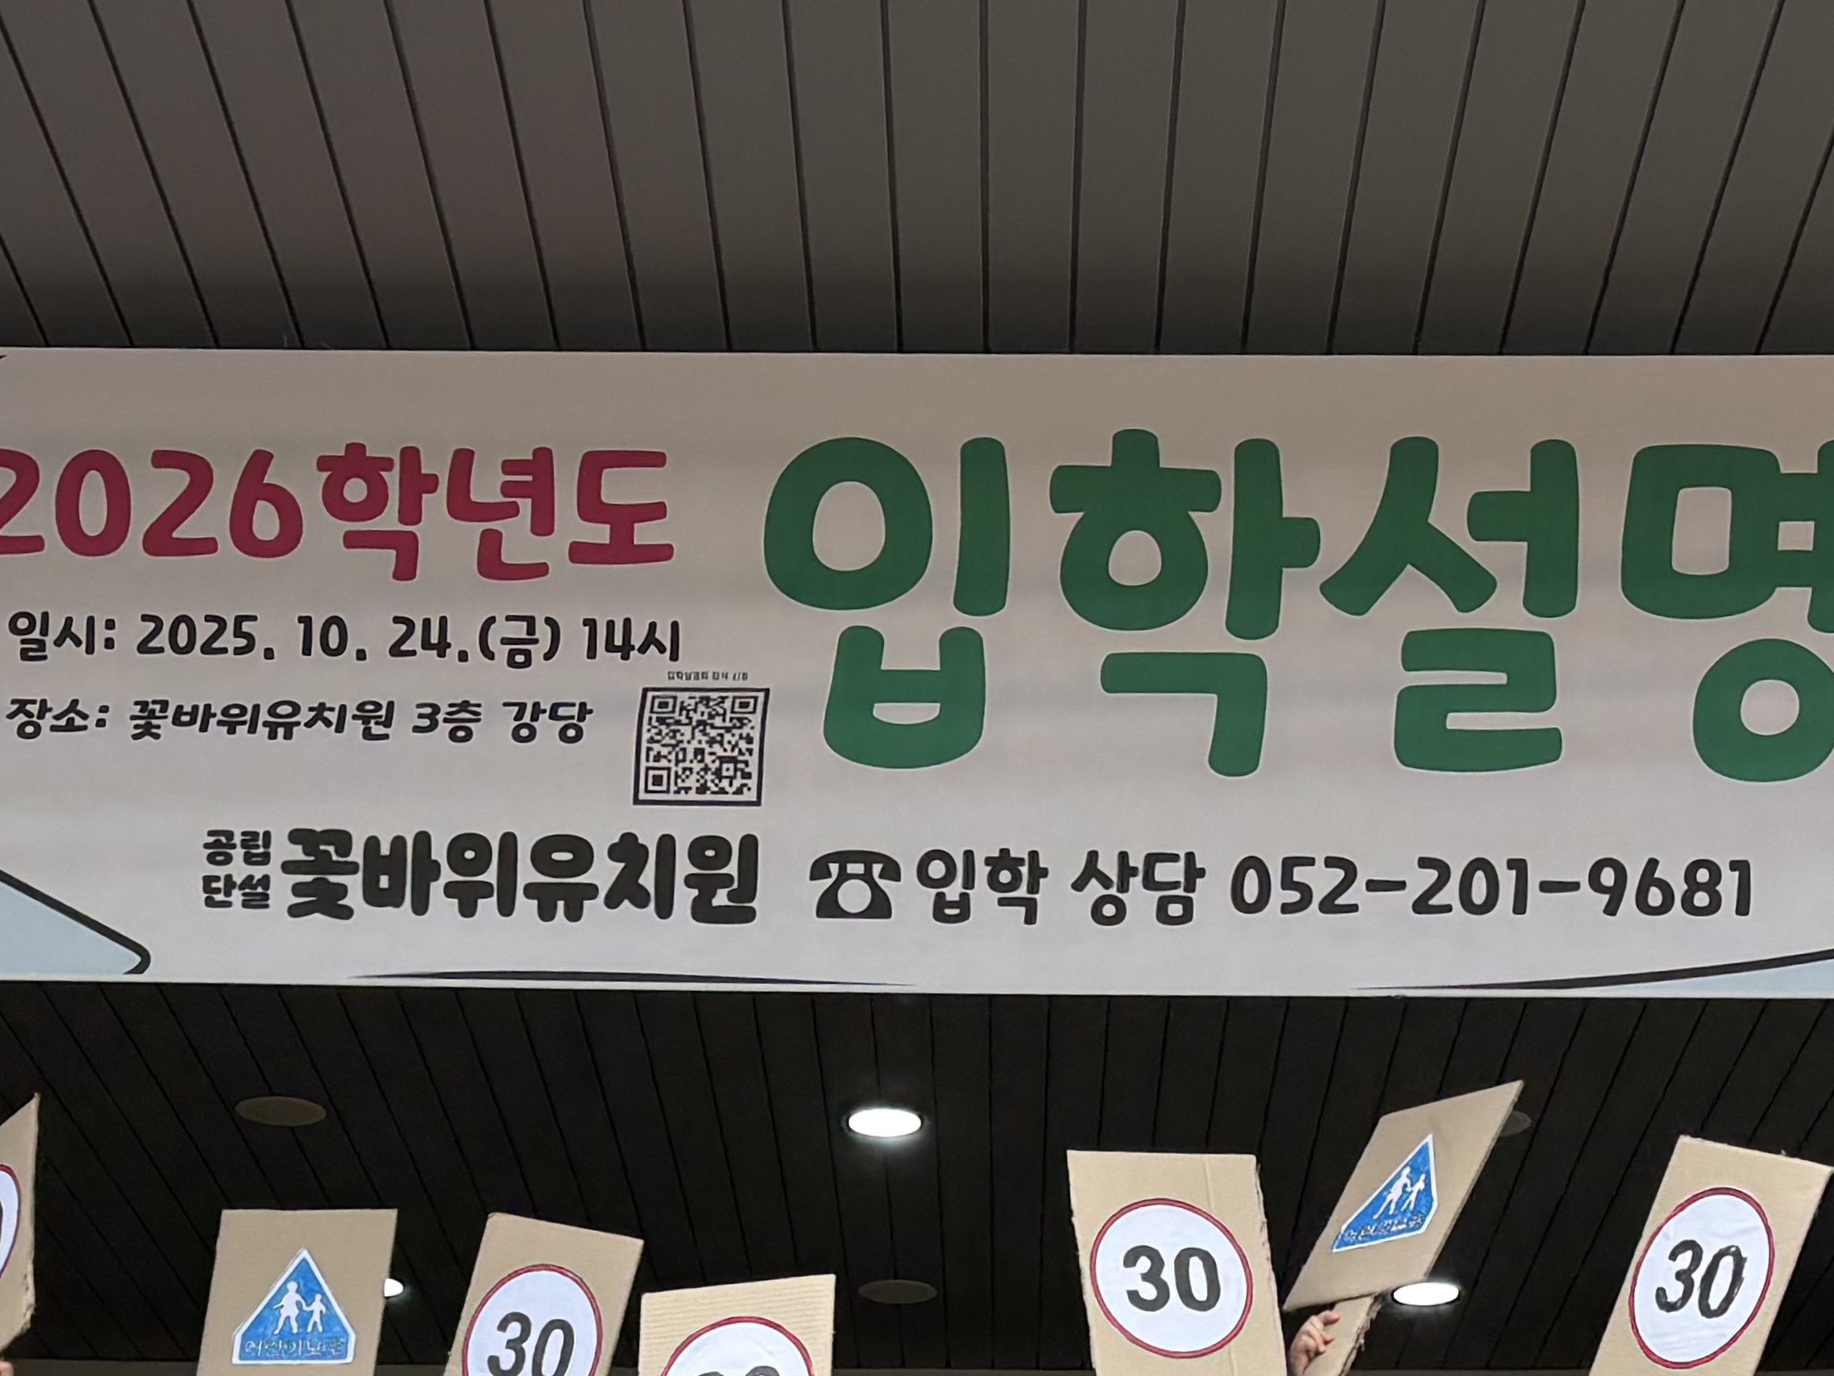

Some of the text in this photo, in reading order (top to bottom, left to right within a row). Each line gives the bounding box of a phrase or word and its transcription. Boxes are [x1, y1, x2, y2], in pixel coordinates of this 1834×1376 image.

[7, 611, 681, 669] 일시: 2025. 10. 24.(금) 14시
[6, 697, 595, 745] 장소: 꽃바위유치원 3층 강당
[202, 829, 273, 864] 공립
[279, 826, 761, 926] 꽃바위유치원
[202, 873, 273, 910] 단설
[915, 845, 1755, 927] 입학 상담 052-201-9681
[1122, 1243, 1221, 1313] 30
[1654, 1238, 1748, 1320] 30
